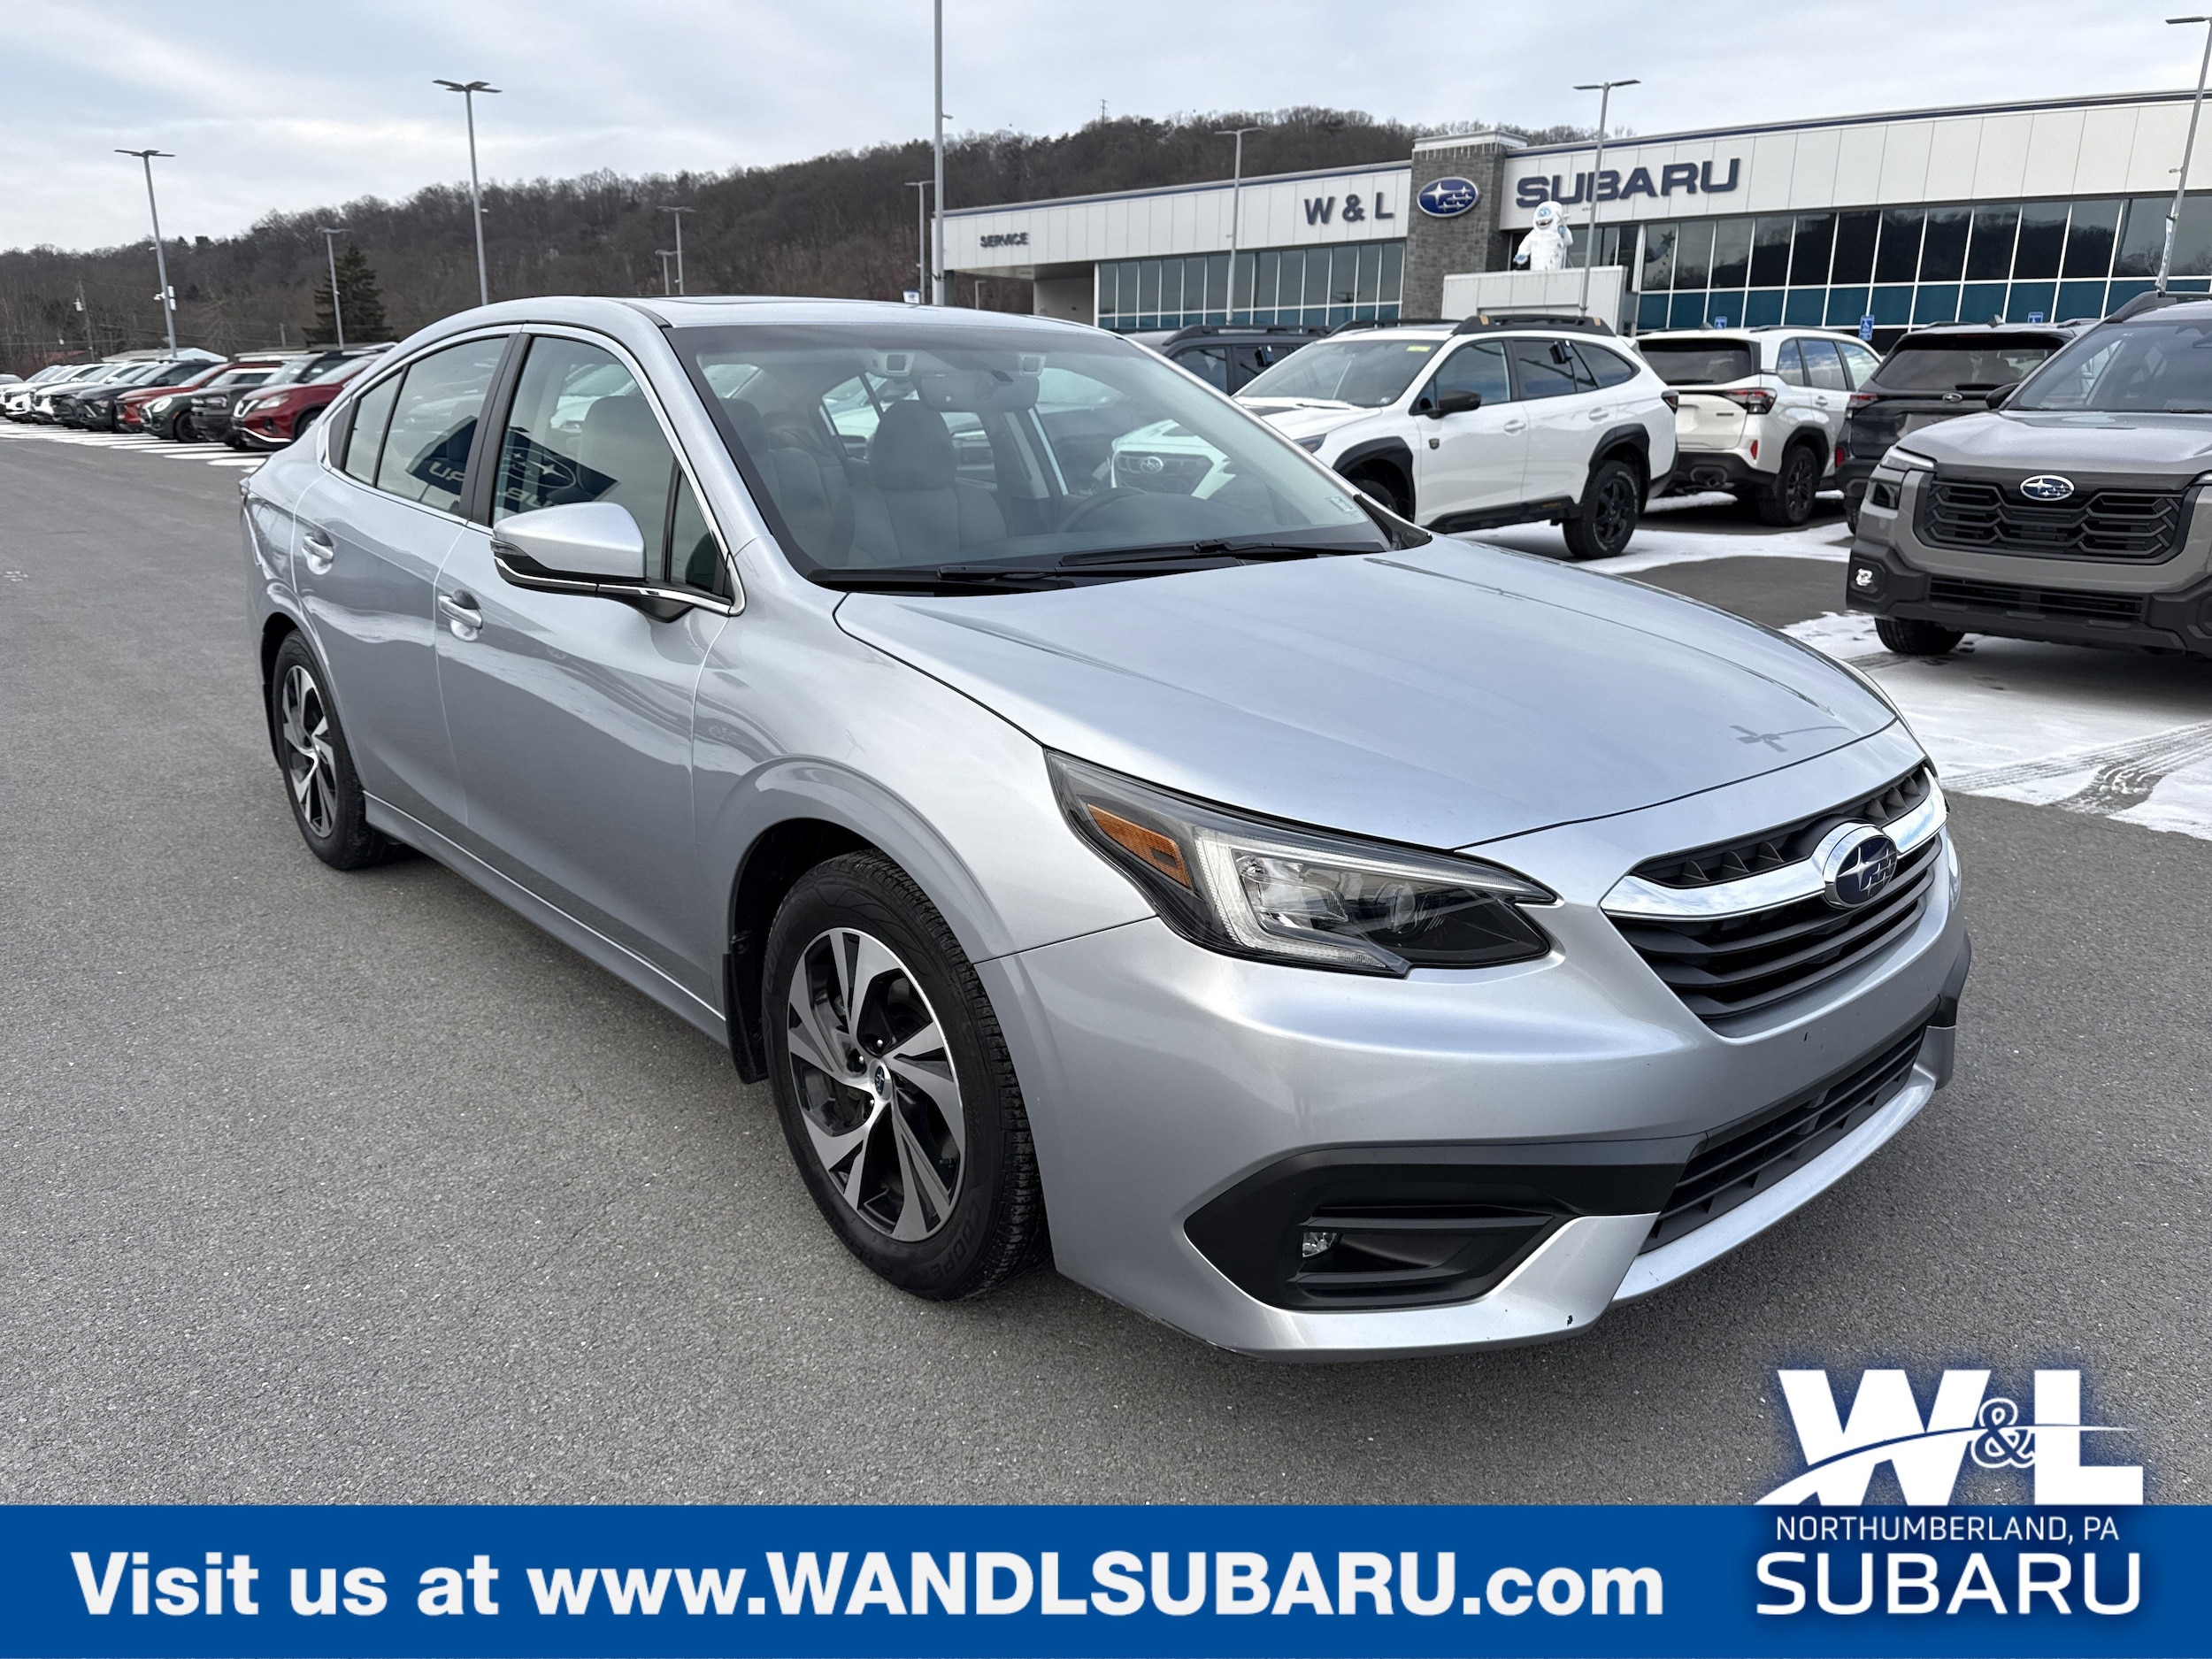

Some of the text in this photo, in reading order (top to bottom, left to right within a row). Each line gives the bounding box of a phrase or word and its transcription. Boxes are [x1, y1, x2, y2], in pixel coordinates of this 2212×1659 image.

[1516, 157, 1740, 208] SUBARU
[1303, 192, 1394, 226] W & L
[979, 232, 1029, 249] SERVICE
